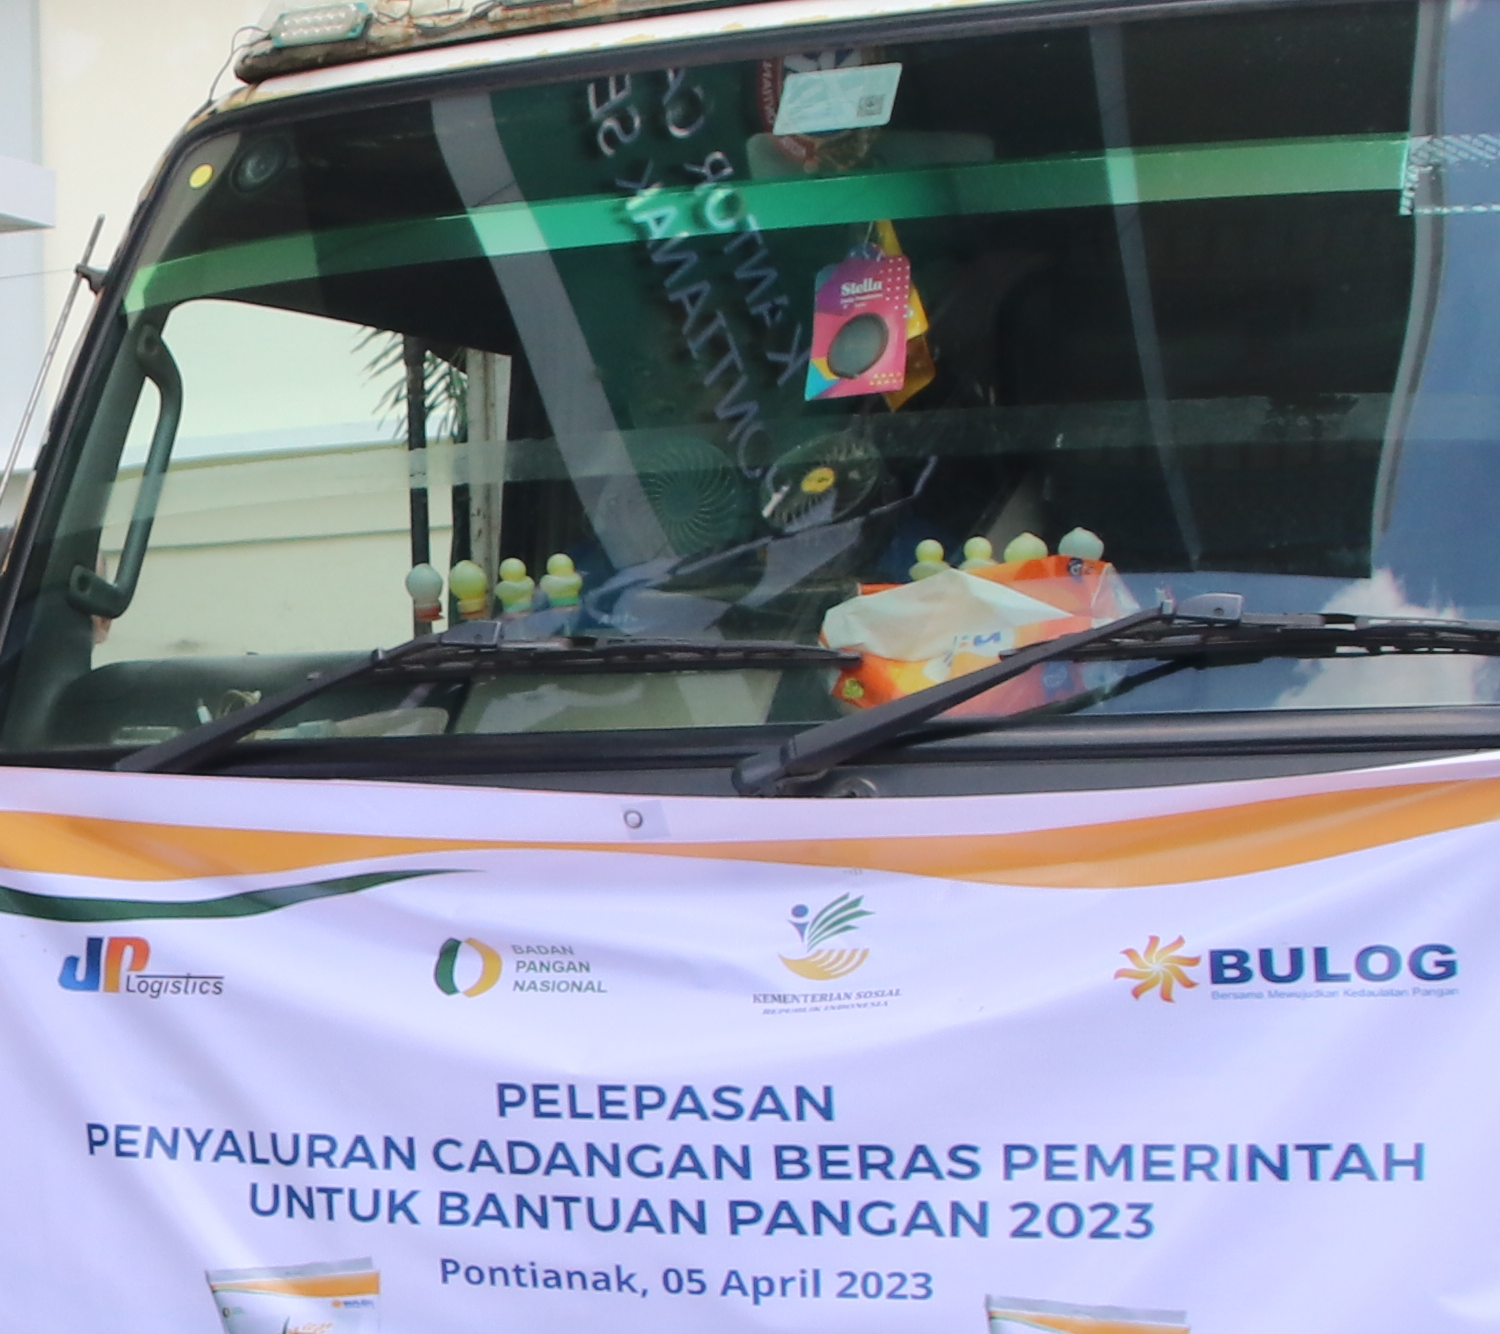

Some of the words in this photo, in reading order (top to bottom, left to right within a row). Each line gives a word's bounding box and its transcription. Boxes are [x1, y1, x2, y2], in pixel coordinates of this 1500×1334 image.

[840, 278, 883, 296] Stella
[511, 944, 575, 956] BADAN
[515, 960, 591, 973] PANGAN
[1208, 942, 1459, 985] BULOG
[126, 973, 225, 999] Logistics
[512, 979, 607, 994] NASIONAL
[752, 991, 852, 1004] KEMENTERIAN
[854, 988, 902, 1000] SOSIAL
[1211, 989, 1265, 1001] Bersama
[1268, 988, 1340, 1000] Mewujudkan
[1343, 987, 1410, 998] Kedaulatan
[1413, 986, 1460, 998] Pangan
[496, 1082, 835, 1122] PELEPASAN
[86, 1123, 416, 1171] PENYALURAN
[432, 1138, 752, 1181] CADANGAN
[773, 1143, 982, 1181] BERAS
[1001, 1141, 1426, 1182] PEMERINTAH
[249, 1182, 421, 1225] UNTUK
[437, 1191, 707, 1236] BANTUAN
[728, 1199, 989, 1237] PANGAN
[1009, 1201, 1155, 1240] 2023
[440, 1258, 650, 1299] Pontianak,
[662, 1267, 708, 1296] 05
[720, 1269, 821, 1306] April
[835, 1271, 934, 1300] 2023
